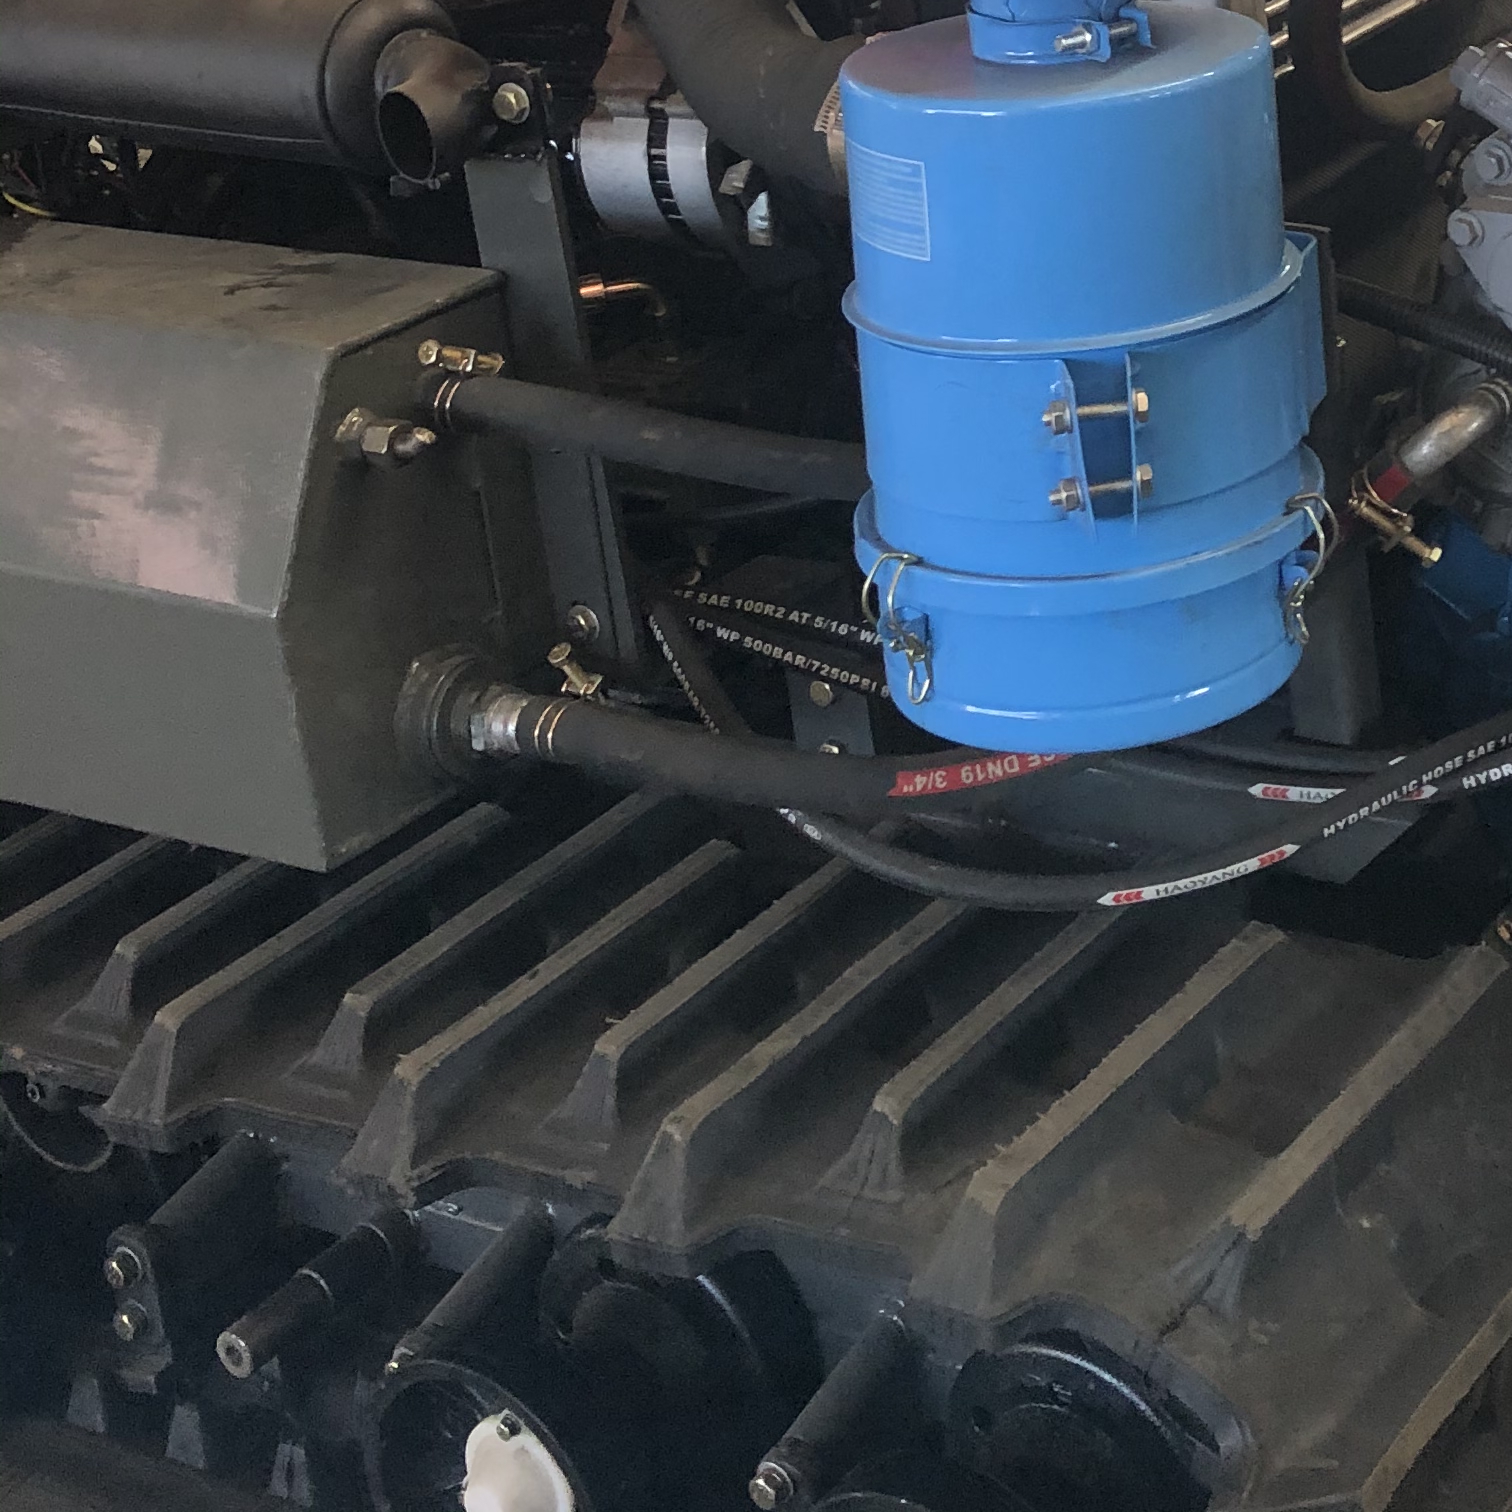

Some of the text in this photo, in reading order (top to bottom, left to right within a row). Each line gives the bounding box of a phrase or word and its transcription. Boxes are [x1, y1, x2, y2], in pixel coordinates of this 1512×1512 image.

[697, 591, 731, 608] SAE
[735, 598, 786, 619] 100R2
[788, 610, 812, 625] AT
[813, 615, 858, 635] 5/16"
[716, 626, 740, 642] WP
[902, 770, 948, 793] 3/4"
[960, 754, 1020, 785] DN19
[1323, 779, 1418, 838] HYDRAULIC
[1421, 755, 1464, 785] HOSE
[1466, 740, 1496, 763] SAE
[1155, 864, 1249, 896] HAOYANG
